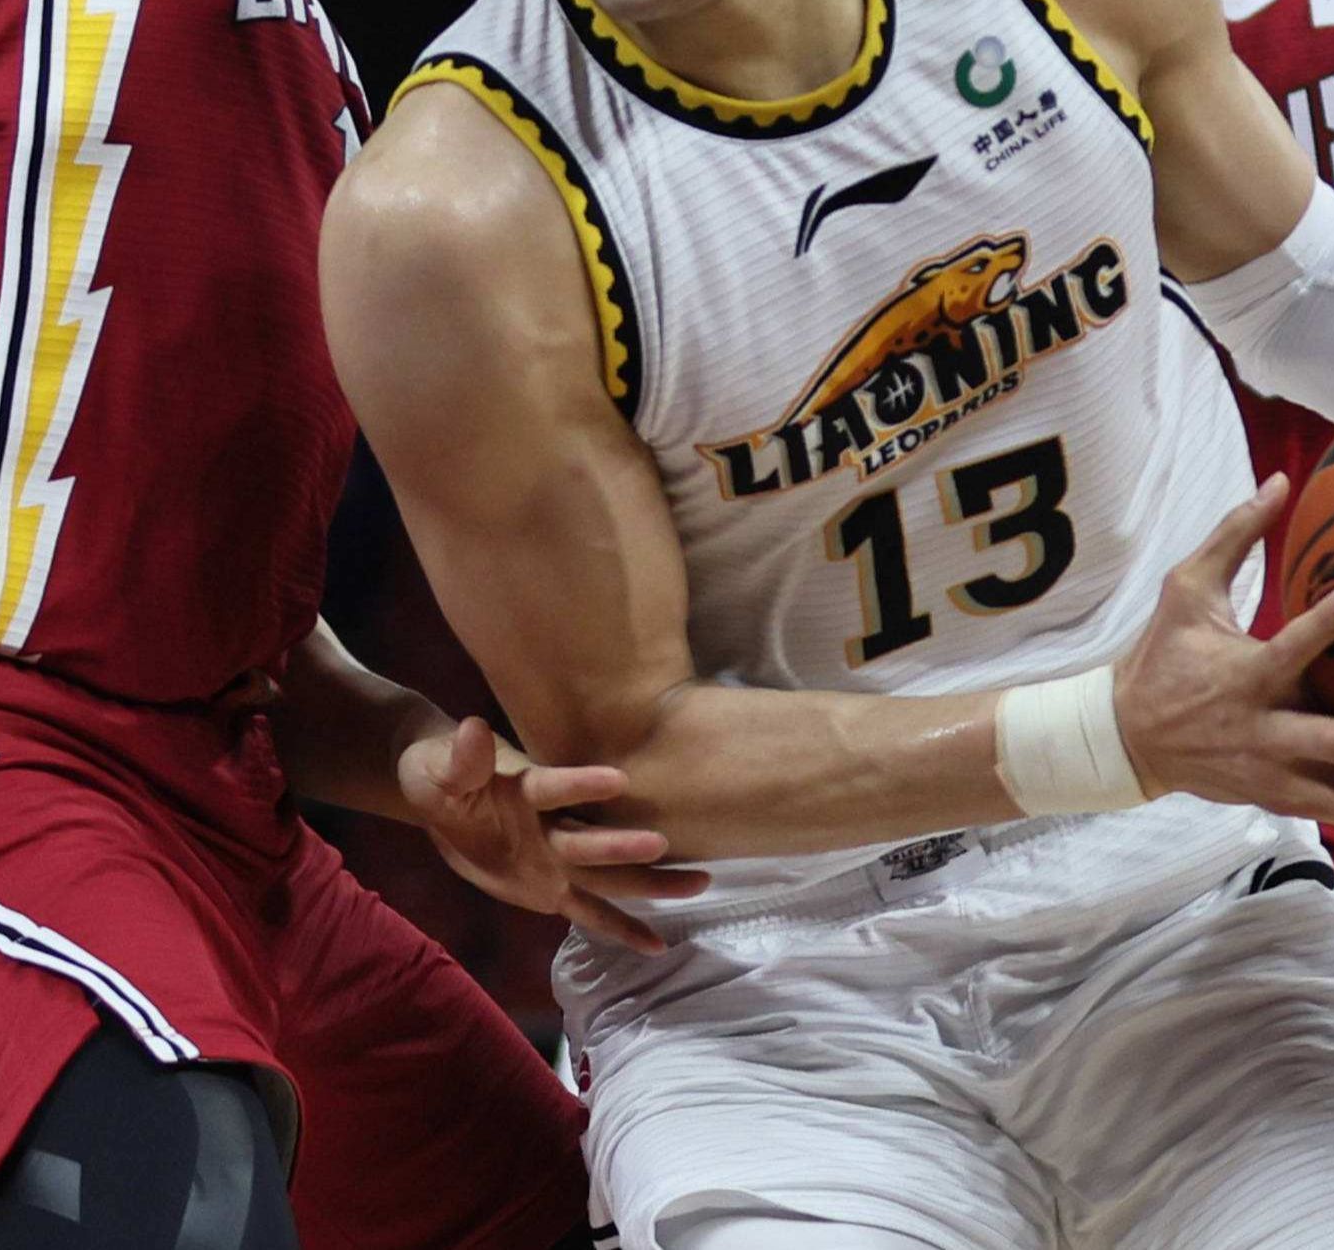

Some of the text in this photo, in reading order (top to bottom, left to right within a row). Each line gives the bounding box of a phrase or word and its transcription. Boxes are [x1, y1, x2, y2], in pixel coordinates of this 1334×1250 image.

[985, 109, 1067, 171] CHINA LIFE
[703, 241, 1130, 498] LIAONING
[863, 371, 1021, 476] LEOPARDS
[824, 435, 1076, 668] 13
